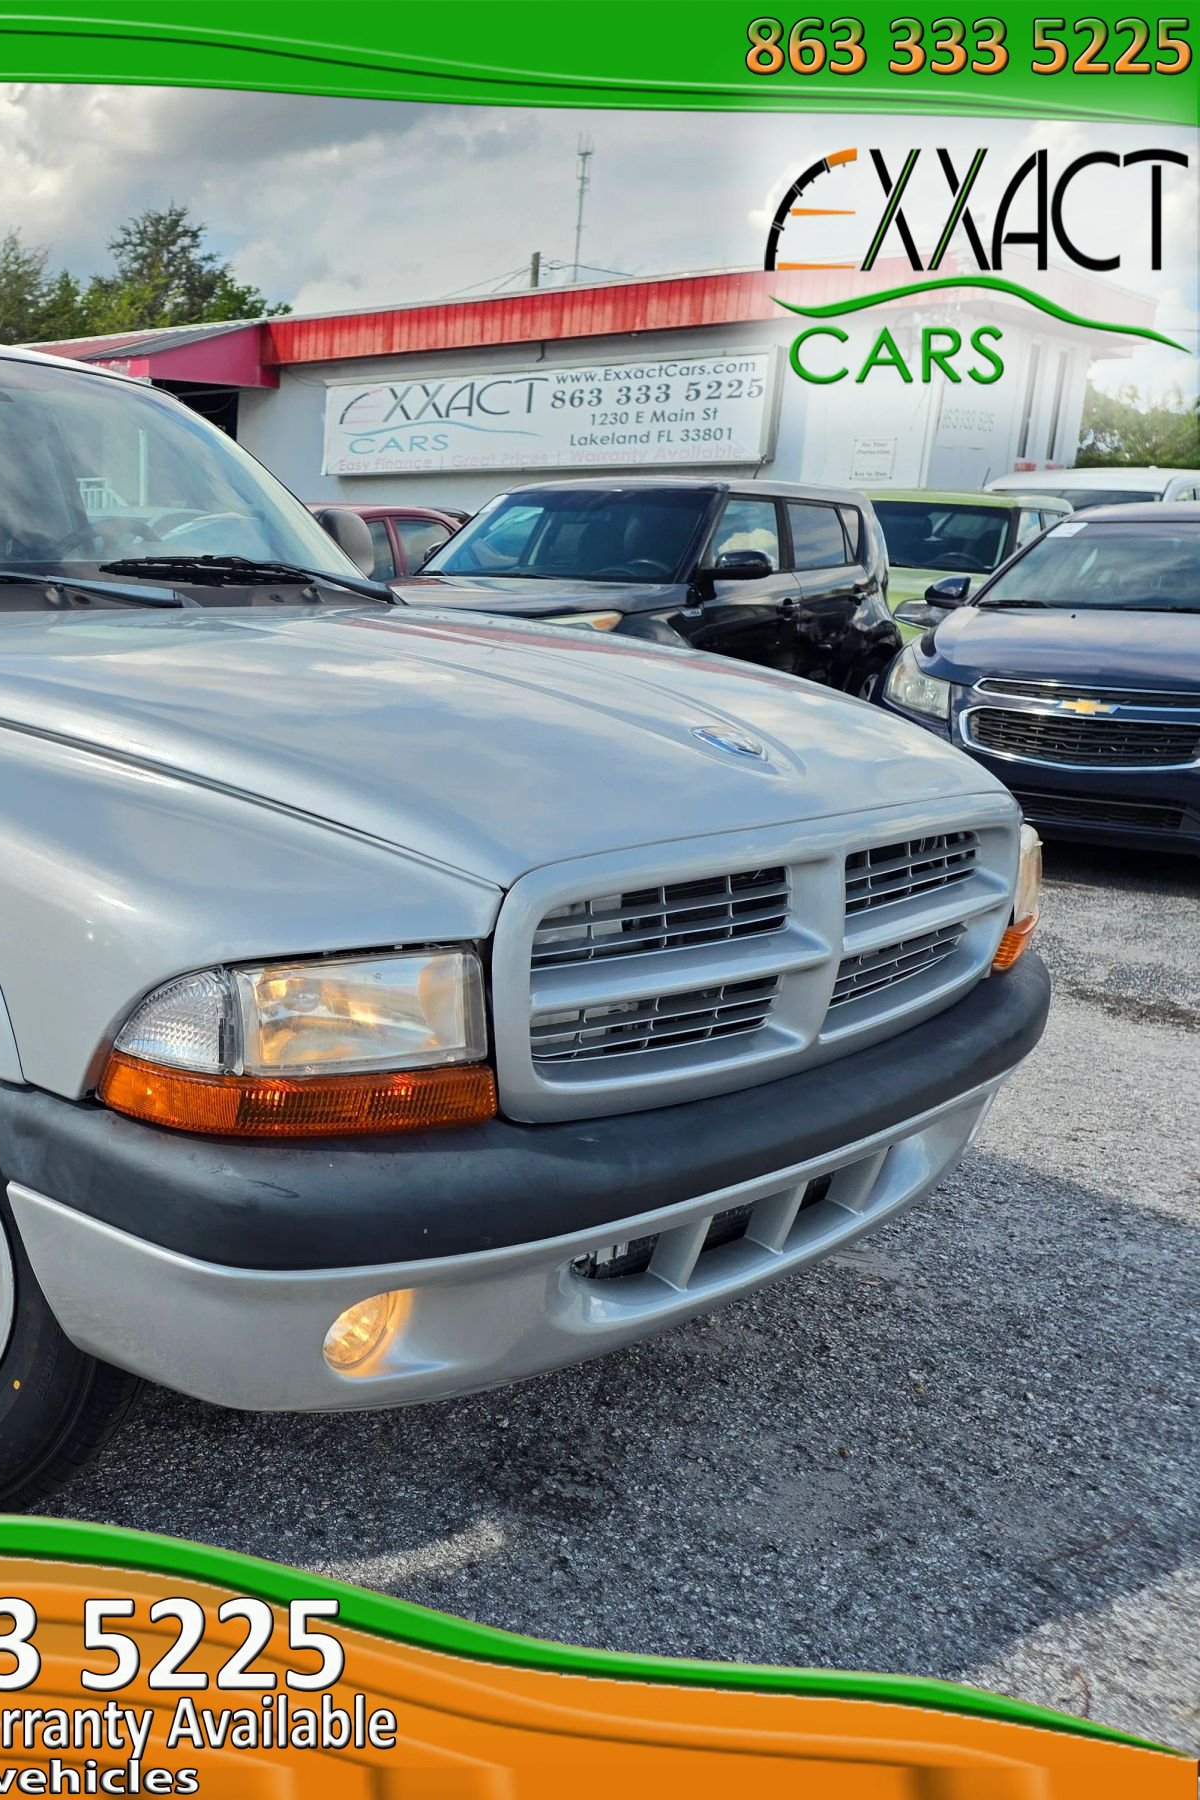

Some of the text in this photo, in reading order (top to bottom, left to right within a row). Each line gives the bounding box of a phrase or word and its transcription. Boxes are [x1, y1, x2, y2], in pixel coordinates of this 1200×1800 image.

[555, 361, 756, 384] www.ExxactCars.com
[339, 377, 549, 425] EXXACT
[551, 378, 765, 409] 863 333 5225
[590, 407, 718, 426] 1230 E Main St
[349, 434, 449, 454] CARS
[570, 427, 732, 446] Lakeland FL 33801
[339, 458, 374, 472] Easy
[570, 447, 649, 464] Warranty
[653, 443, 745, 461] Available
